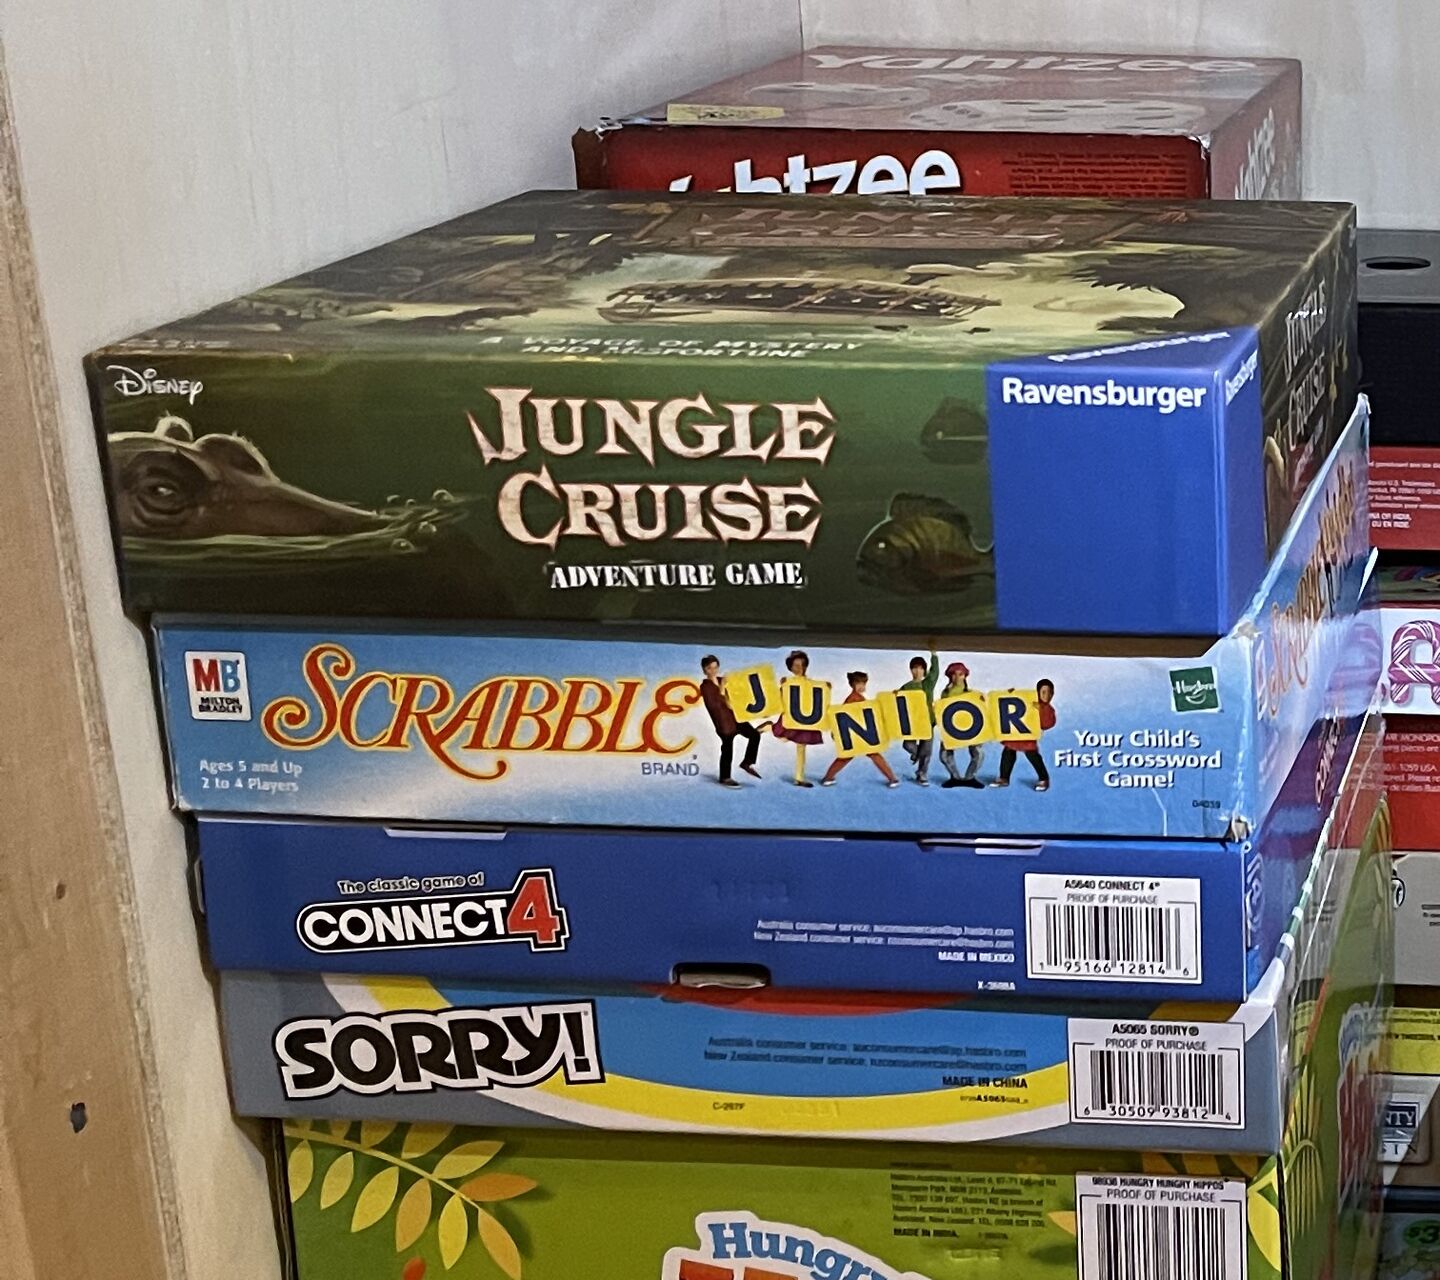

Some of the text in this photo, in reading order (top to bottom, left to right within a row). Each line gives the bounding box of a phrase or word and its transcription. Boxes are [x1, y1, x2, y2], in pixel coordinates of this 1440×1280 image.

[106, 364, 204, 404] Disney
[1001, 377, 1207, 414] Ravensburger
[466, 385, 837, 467] JUNGLE
[499, 462, 823, 550] CRUISE
[550, 560, 806, 590] ADVENTURE GAME
[192, 659, 241, 693] MB
[261, 642, 702, 781] SCRABBLE
[745, 671, 1033, 752] JUNIOR
[1074, 730, 1201, 748] Your Child's
[200, 759, 303, 779] Ages 5 and Up
[641, 761, 700, 777] BRAND
[1054, 750, 1221, 770] First Crossword
[248, 779, 299, 794] Players
[1103, 770, 1175, 790] Game!
[338, 872, 485, 896] The classic game of
[304, 876, 560, 948] CONNECT 4
[1064, 962, 1166, 975] 95166 12814
[283, 1010, 590, 1091] SORRY!
[1105, 1038, 1208, 1051] PROOF OF PURCHASE
[1109, 1105, 1209, 1119] 30509 93812
[1106, 1188, 1216, 1203] PROOF PURCHASE
